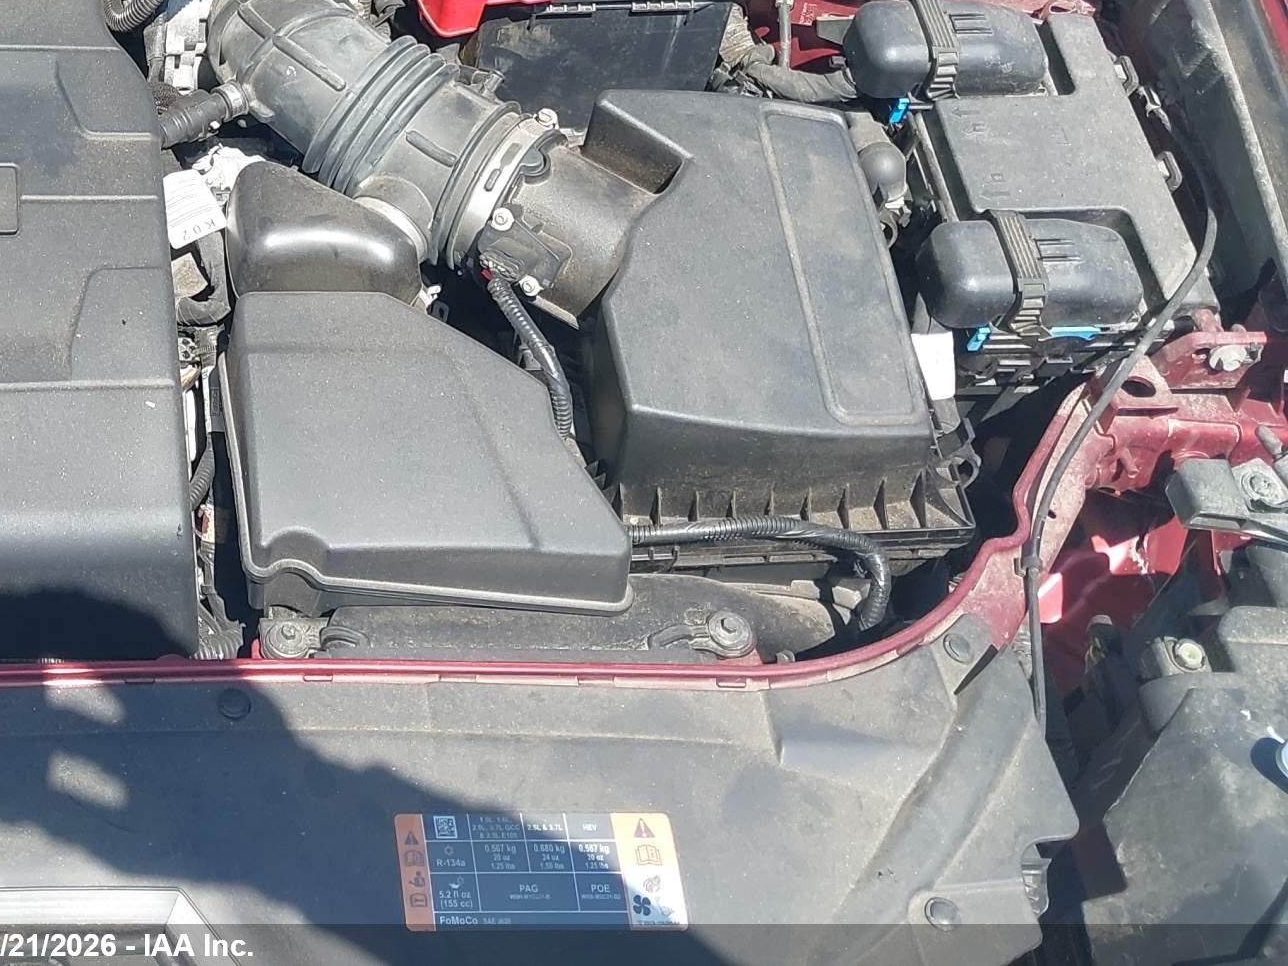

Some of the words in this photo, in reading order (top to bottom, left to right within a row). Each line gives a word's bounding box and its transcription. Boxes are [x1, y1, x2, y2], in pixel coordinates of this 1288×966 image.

[507, 845, 517, 854] kg
[555, 844, 566, 854] kg
[600, 844, 610, 854] kg
[436, 858, 466, 867] R-134a
[519, 884, 538, 892] PAG
[590, 884, 610, 892] POE
[439, 890, 451, 898] 5.2
[439, 916, 478, 925] FoMoCo
